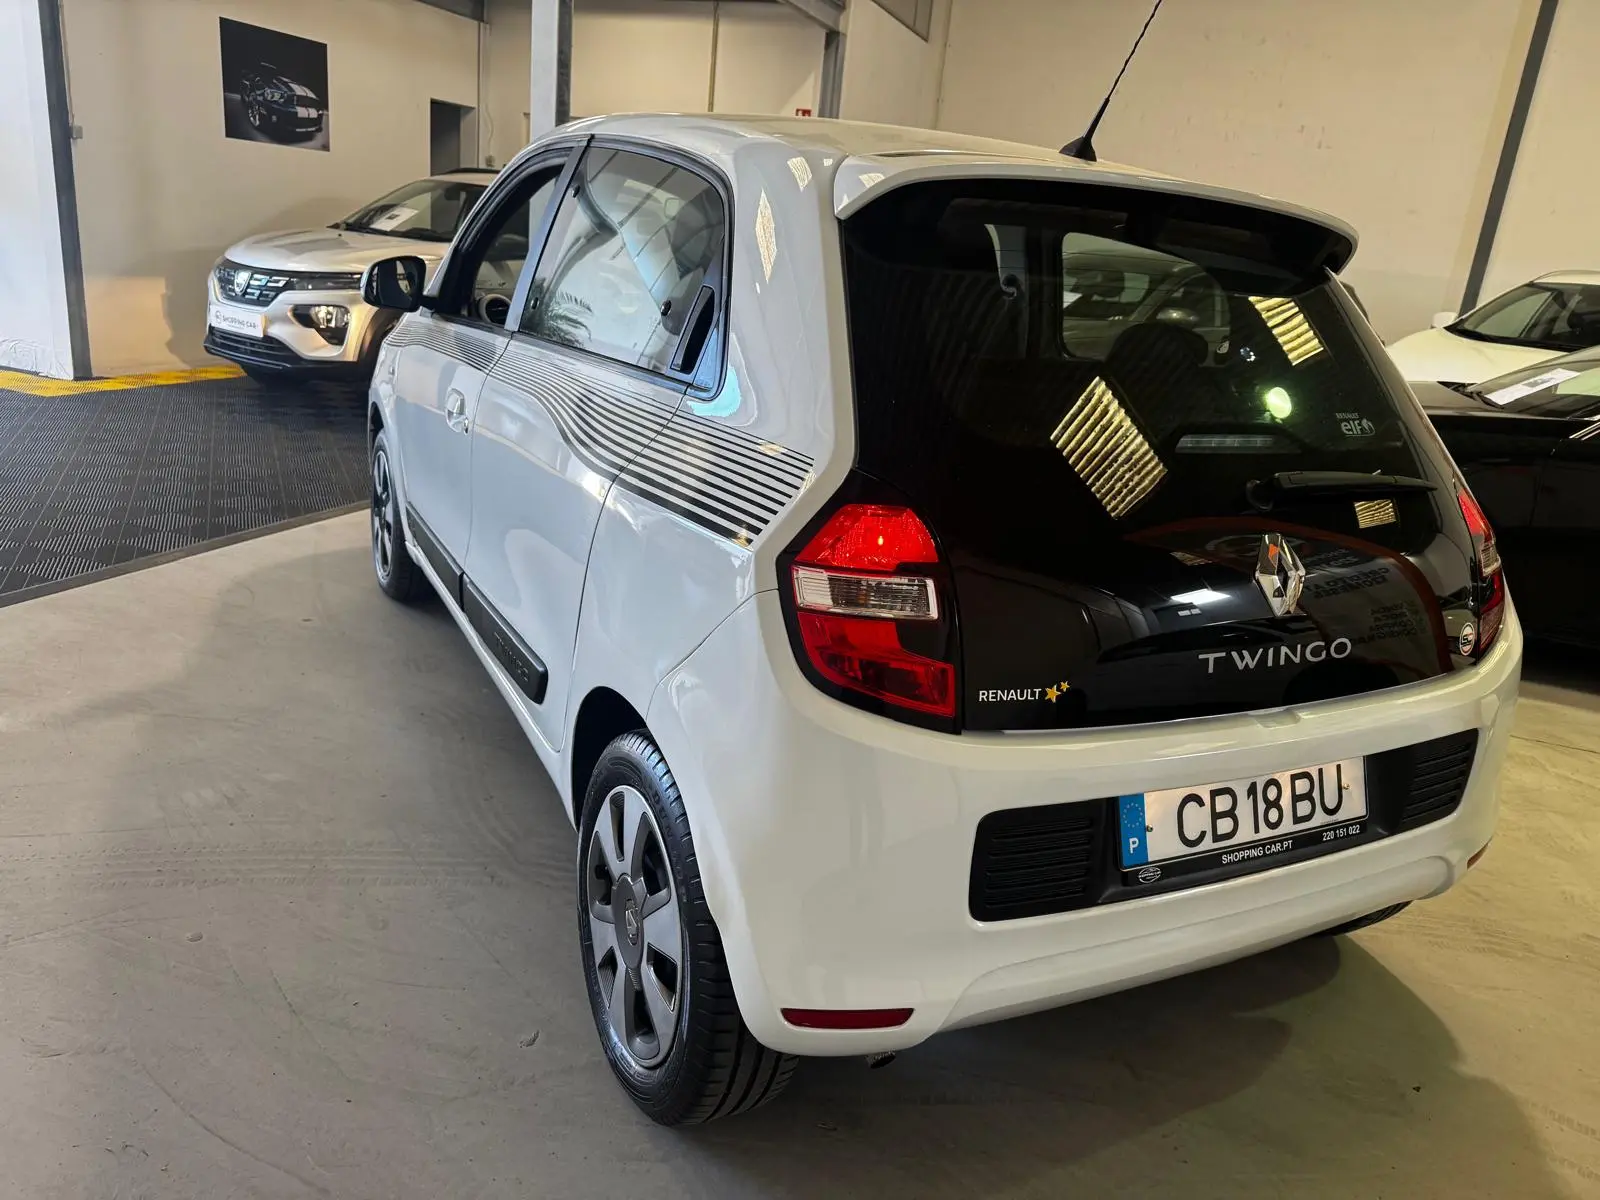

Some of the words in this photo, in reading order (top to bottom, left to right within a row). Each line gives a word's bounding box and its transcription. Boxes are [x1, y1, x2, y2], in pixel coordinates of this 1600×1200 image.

[1198, 637, 1352, 674] TWINGO
[979, 688, 1042, 702] RENAULT
[1322, 831, 1335, 841] 220
[1336, 828, 1347, 838] 151
[1348, 824, 1360, 835] 022
[1128, 837, 1139, 854] P
[1222, 846, 1264, 864] SHOPPING
[1265, 840, 1293, 855] CAR.PT
